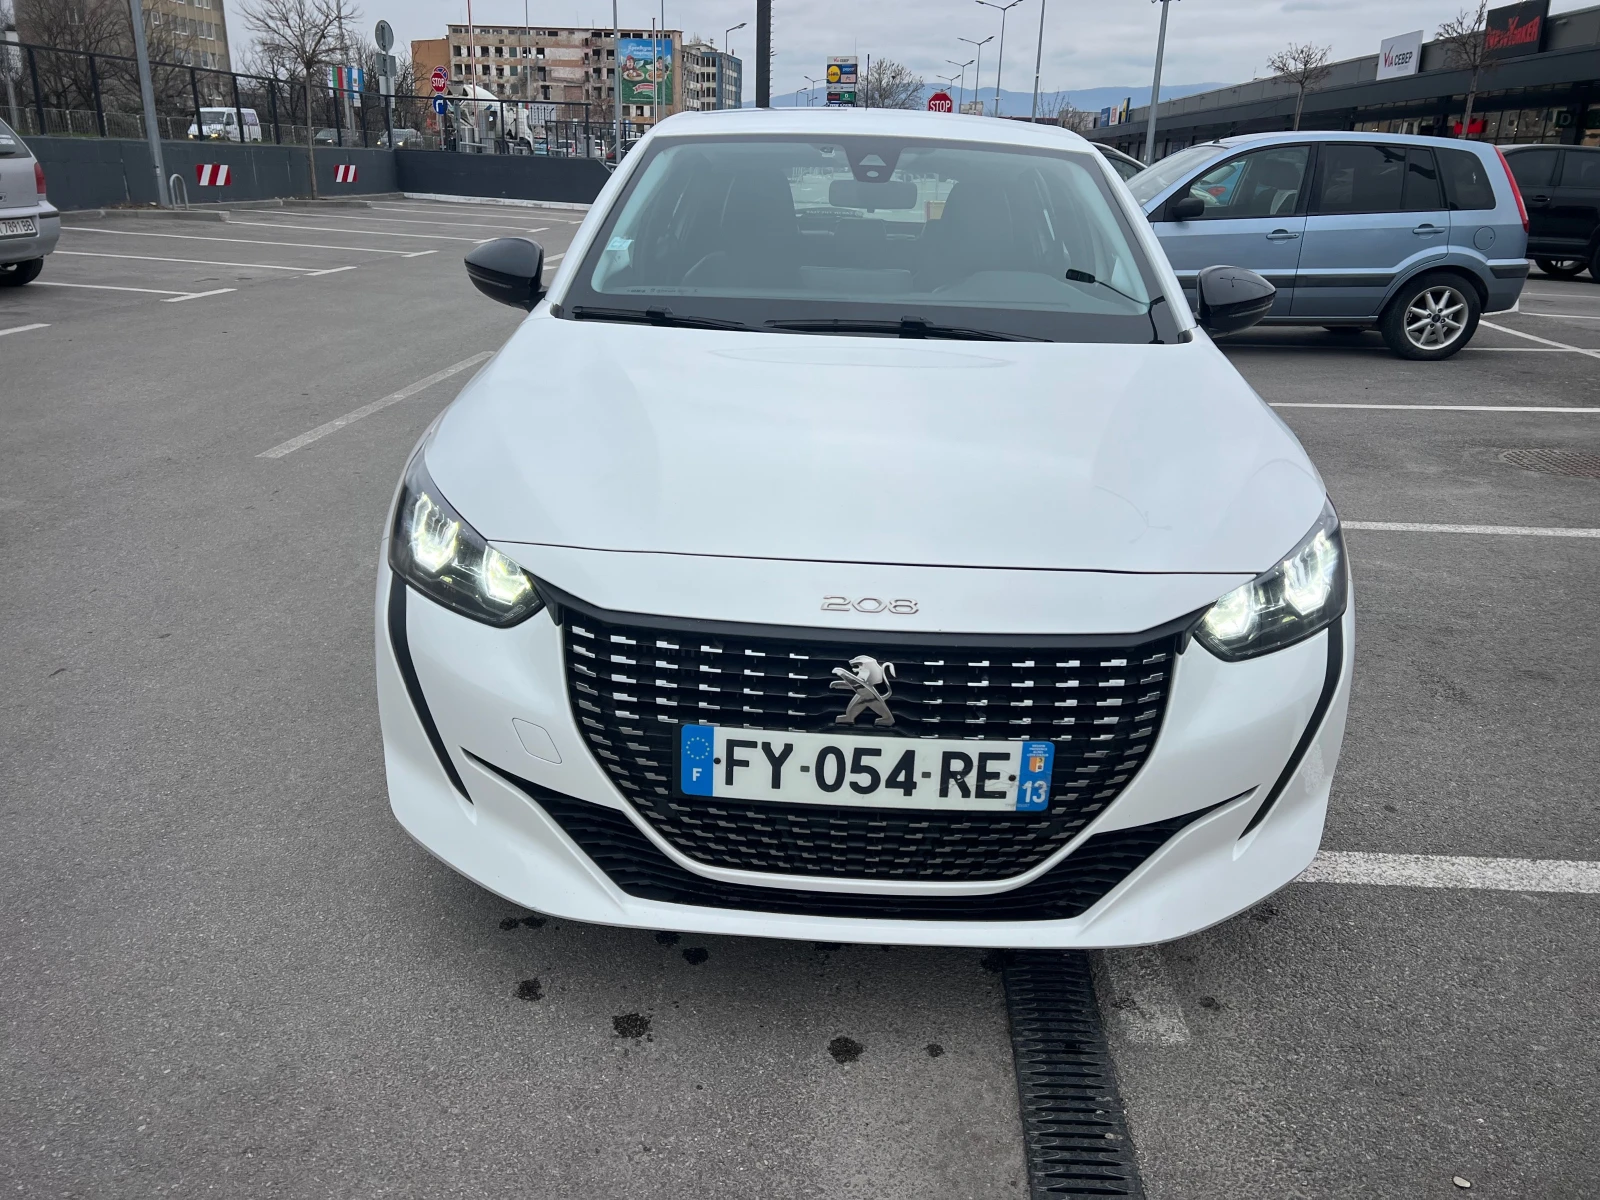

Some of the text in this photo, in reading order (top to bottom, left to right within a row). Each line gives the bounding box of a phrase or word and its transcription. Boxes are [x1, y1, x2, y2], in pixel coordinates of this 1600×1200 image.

[432, 77, 445, 87] STOP
[930, 100, 951, 112] STOP
[820, 594, 920, 615] 208
[692, 767, 703, 782] F
[1022, 780, 1047, 804] 13
